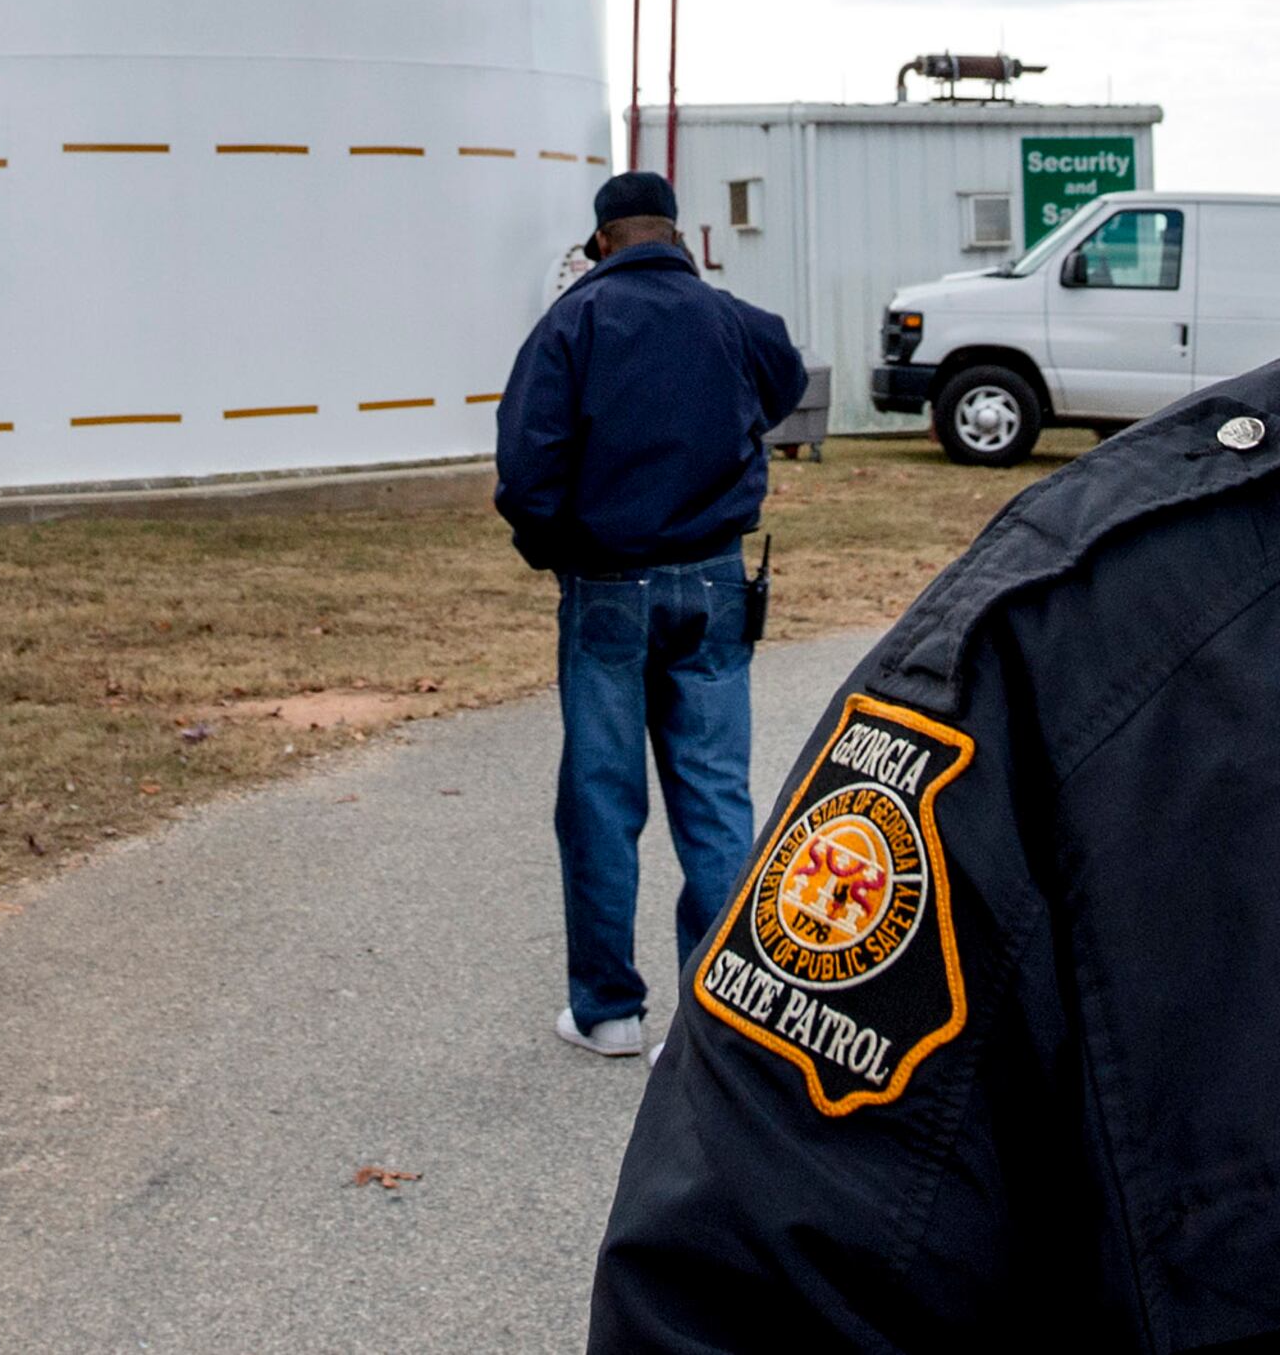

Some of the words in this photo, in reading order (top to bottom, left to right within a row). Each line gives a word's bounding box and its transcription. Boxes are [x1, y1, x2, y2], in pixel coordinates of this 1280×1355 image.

[1027, 151, 1130, 177] Security
[1064, 179, 1097, 195] and
[830, 722, 931, 795] GEORGIA
[812, 790, 850, 826] STATE
[853, 789, 876, 814] OF
[871, 796, 918, 872] GEORGIA
[757, 824, 807, 948] DEPARTMENT
[773, 940, 799, 968] OF
[866, 884, 920, 962] SAFETY
[794, 946, 867, 980] PUBLIC
[703, 950, 784, 1022] STATE
[775, 987, 890, 1085] PATROL
